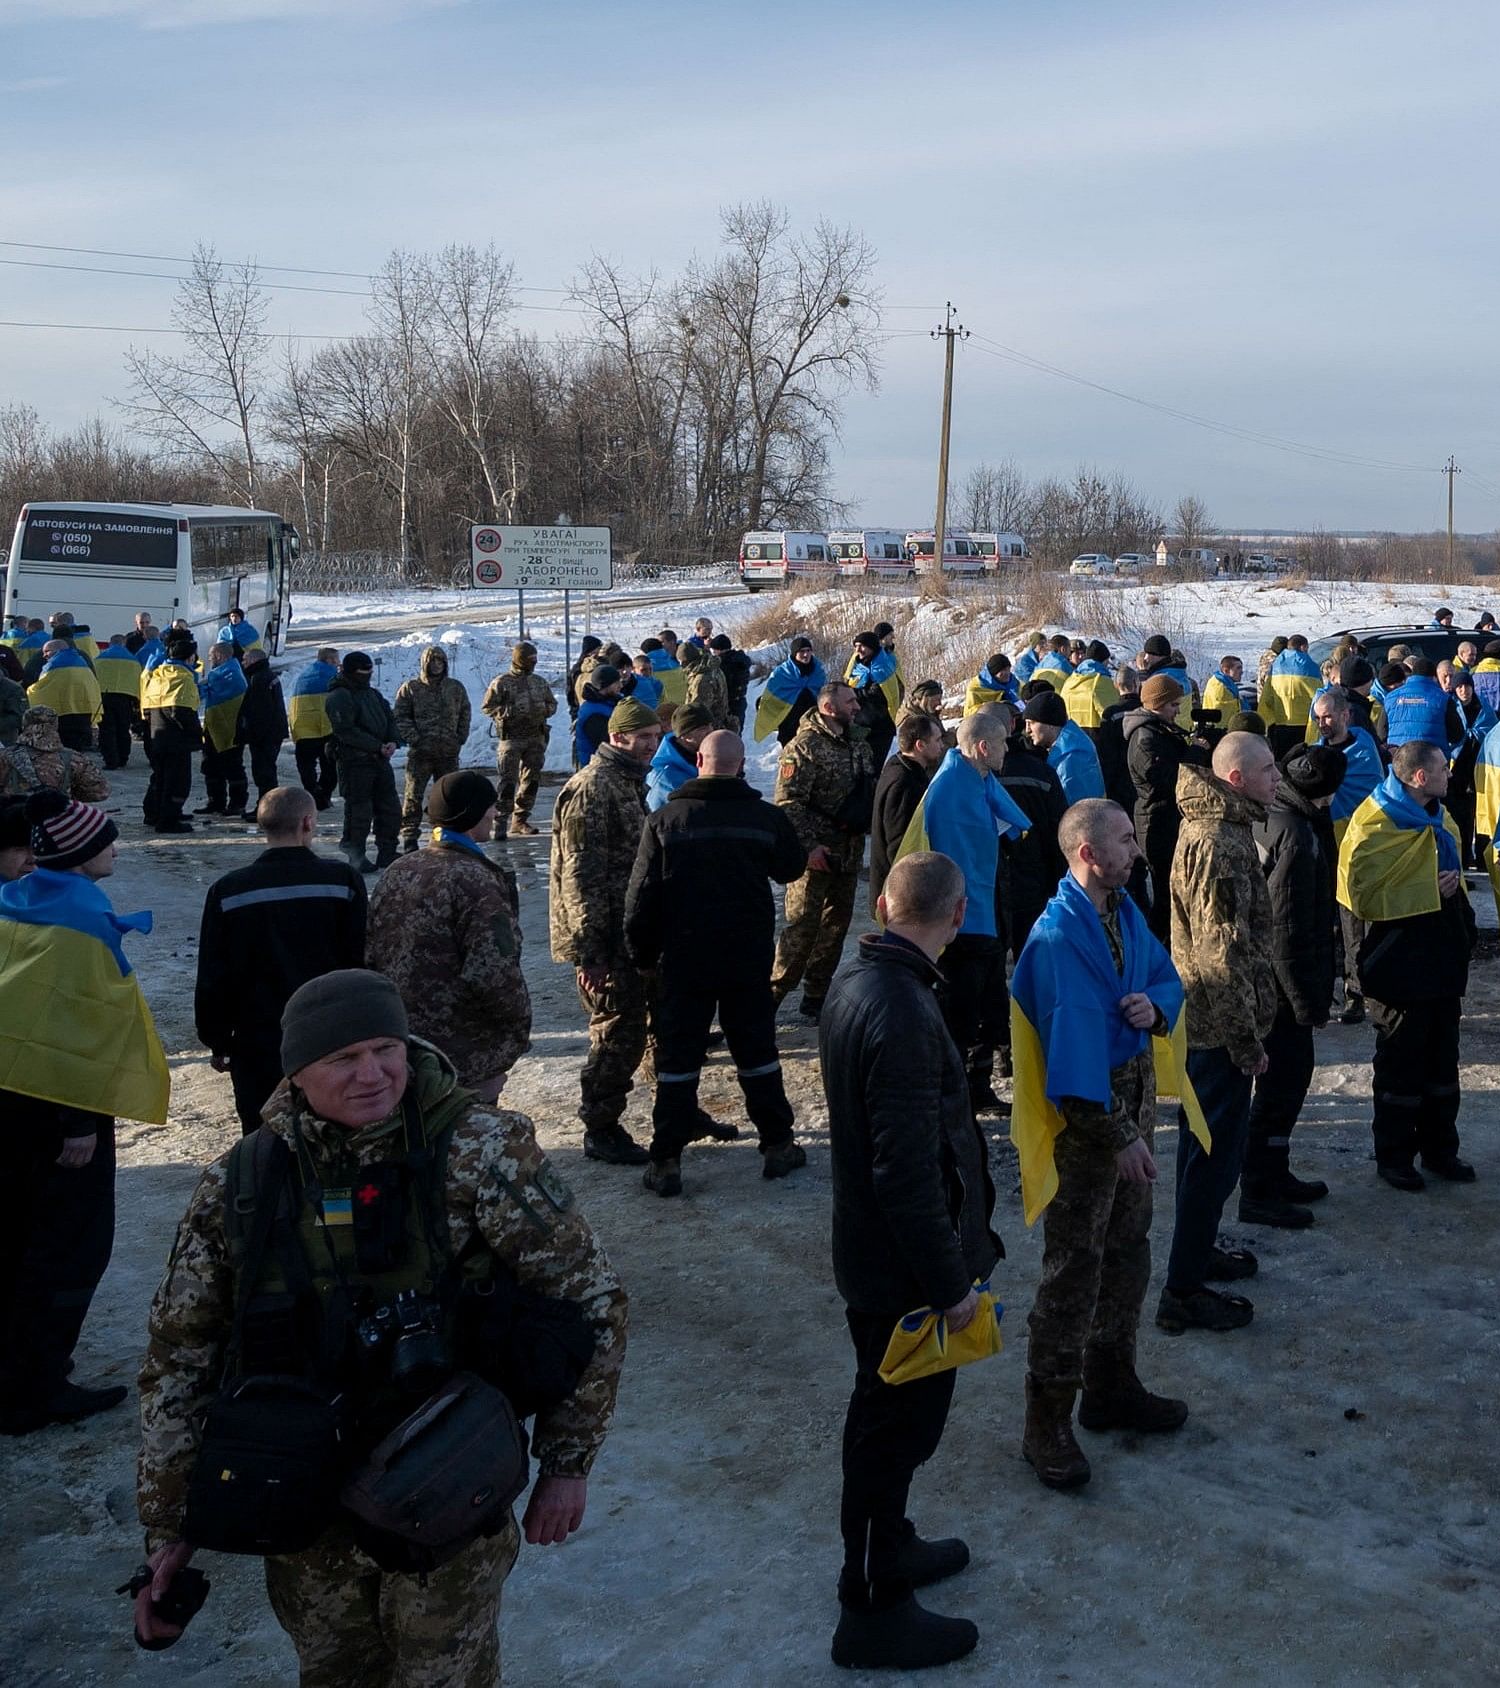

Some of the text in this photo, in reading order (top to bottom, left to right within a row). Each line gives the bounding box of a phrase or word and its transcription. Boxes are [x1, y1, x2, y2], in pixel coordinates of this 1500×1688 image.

[31, 519, 173, 535] АВТОБУСИ НА ЗАМОВЛЕННЯ
[63, 533, 92, 544] (050)
[62, 545, 91, 556] (066)
[518, 566, 599, 576] ЗАБОРОНЕНО
